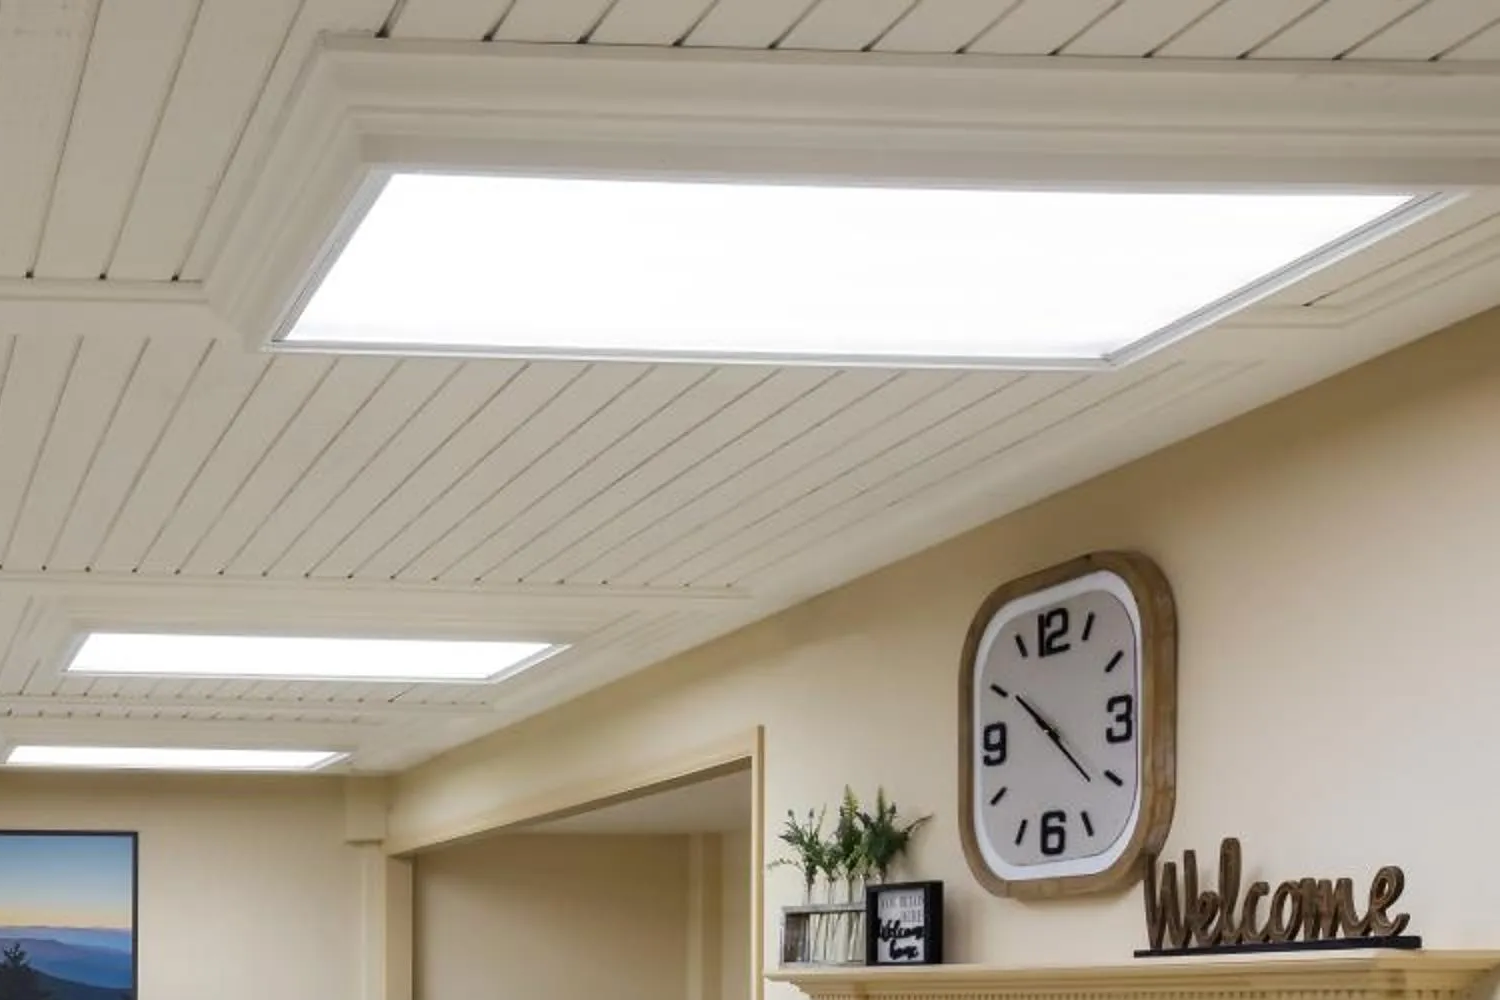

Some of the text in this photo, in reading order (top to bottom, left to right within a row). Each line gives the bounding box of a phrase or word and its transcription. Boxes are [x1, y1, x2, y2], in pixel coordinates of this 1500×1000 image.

[1037, 606, 1071, 658] 12
[982, 721, 1008, 767] 9
[1105, 694, 1133, 744] 3
[1039, 810, 1067, 856] 6
[1143, 837, 1411, 950] Welcome
